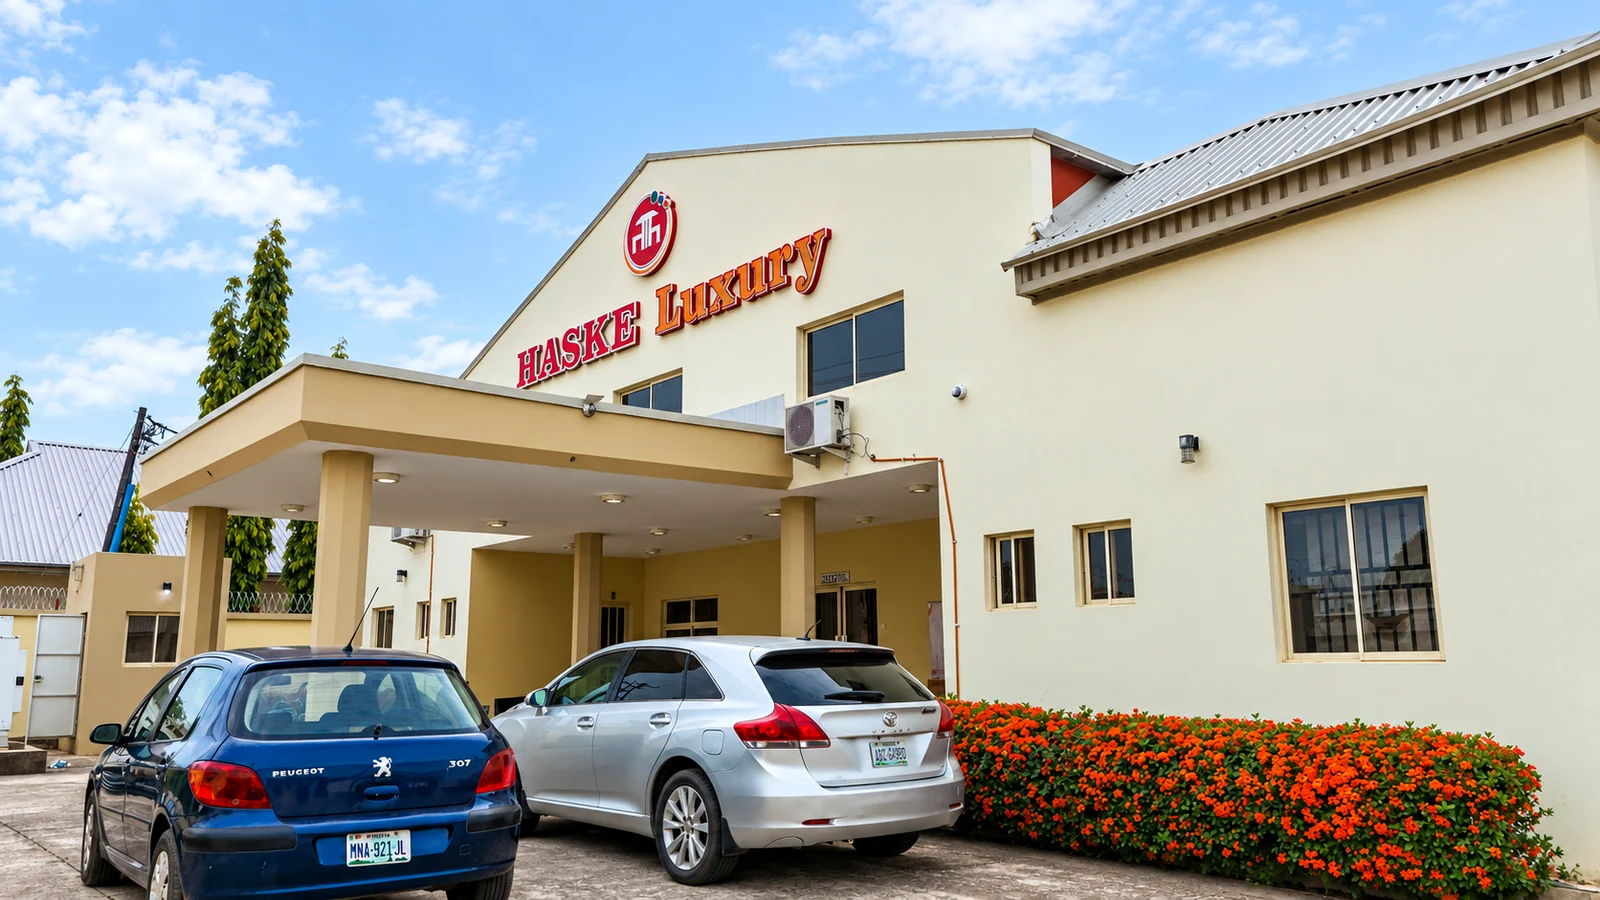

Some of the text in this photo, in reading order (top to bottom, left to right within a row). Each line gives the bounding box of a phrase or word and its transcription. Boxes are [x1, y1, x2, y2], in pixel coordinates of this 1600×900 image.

[516, 227, 832, 388] HASKE Luxury
[448, 759, 472, 768] 307
[272, 767, 325, 777] PEUGEOT
